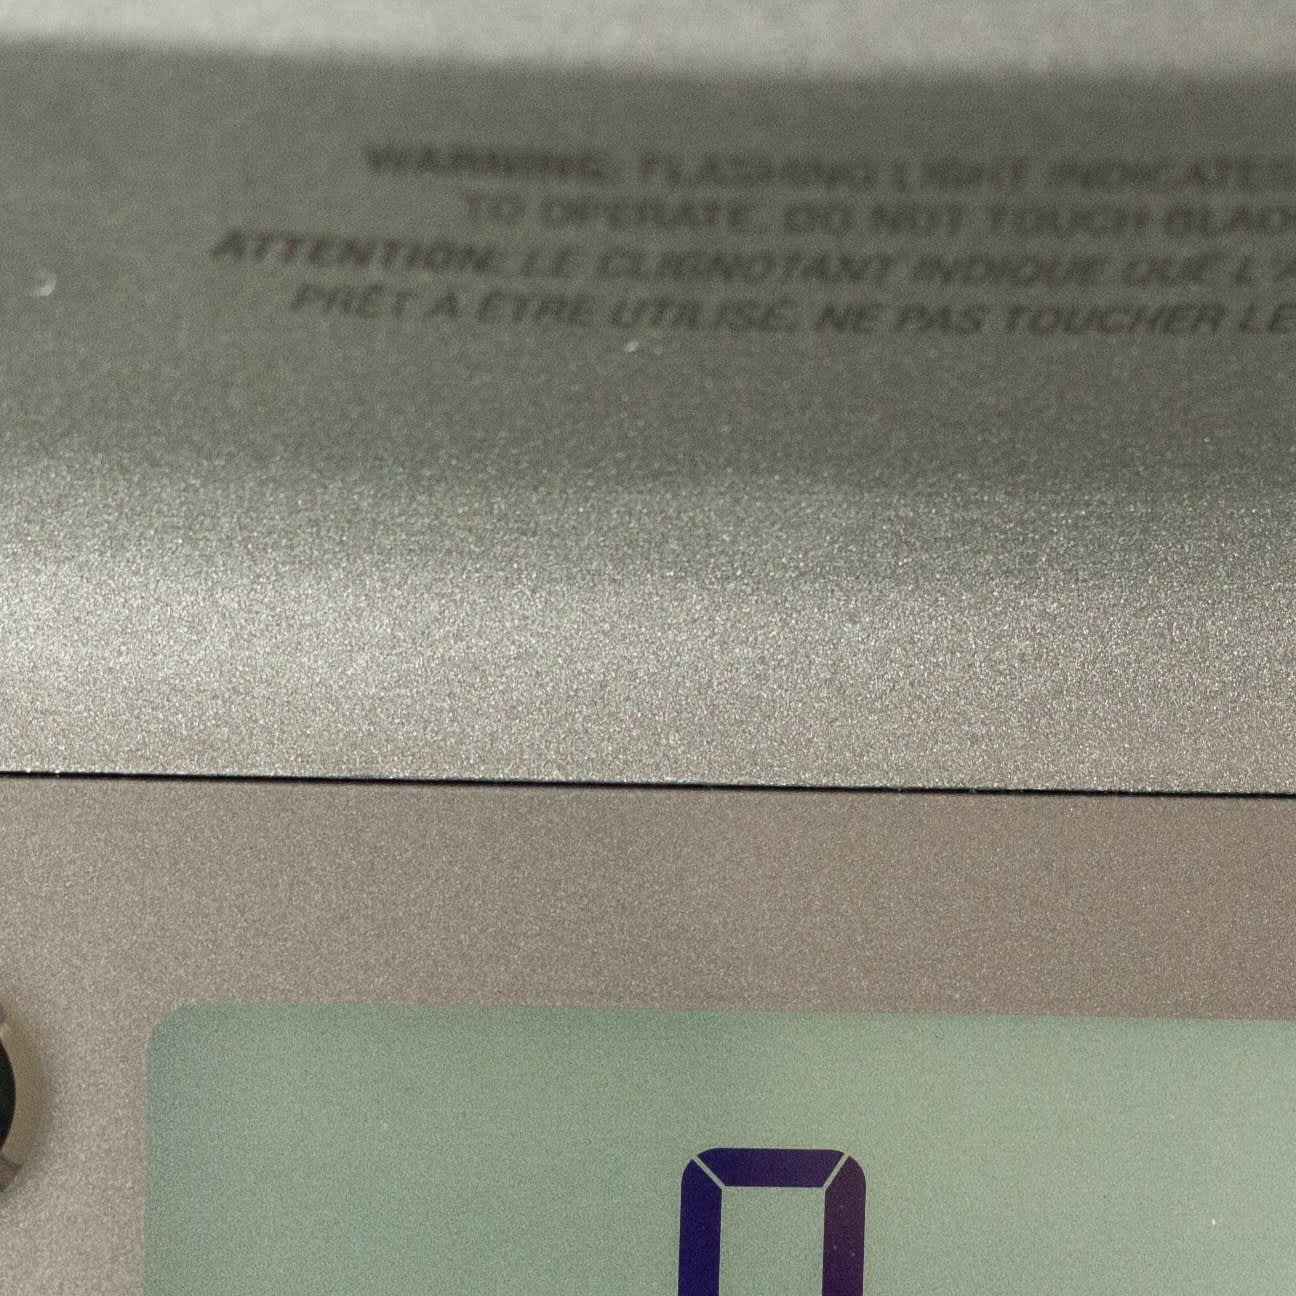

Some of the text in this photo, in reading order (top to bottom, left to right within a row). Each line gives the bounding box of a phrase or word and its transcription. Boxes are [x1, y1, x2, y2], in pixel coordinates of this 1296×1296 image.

[891, 156, 1026, 191] LIGHT
[1050, 155, 1296, 189] INDICATES
[464, 194, 523, 226] TO
[785, 202, 855, 236] DO
[870, 204, 965, 236] NOT
[989, 204, 1151, 236] TOUCH
[523, 245, 580, 278] LE
[912, 253, 1105, 288] INDIQUE
[1123, 252, 1221, 287] QUE
[815, 302, 881, 334] NE
[896, 303, 989, 334] PAS
[1006, 303, 1227, 335] TOUCHER
